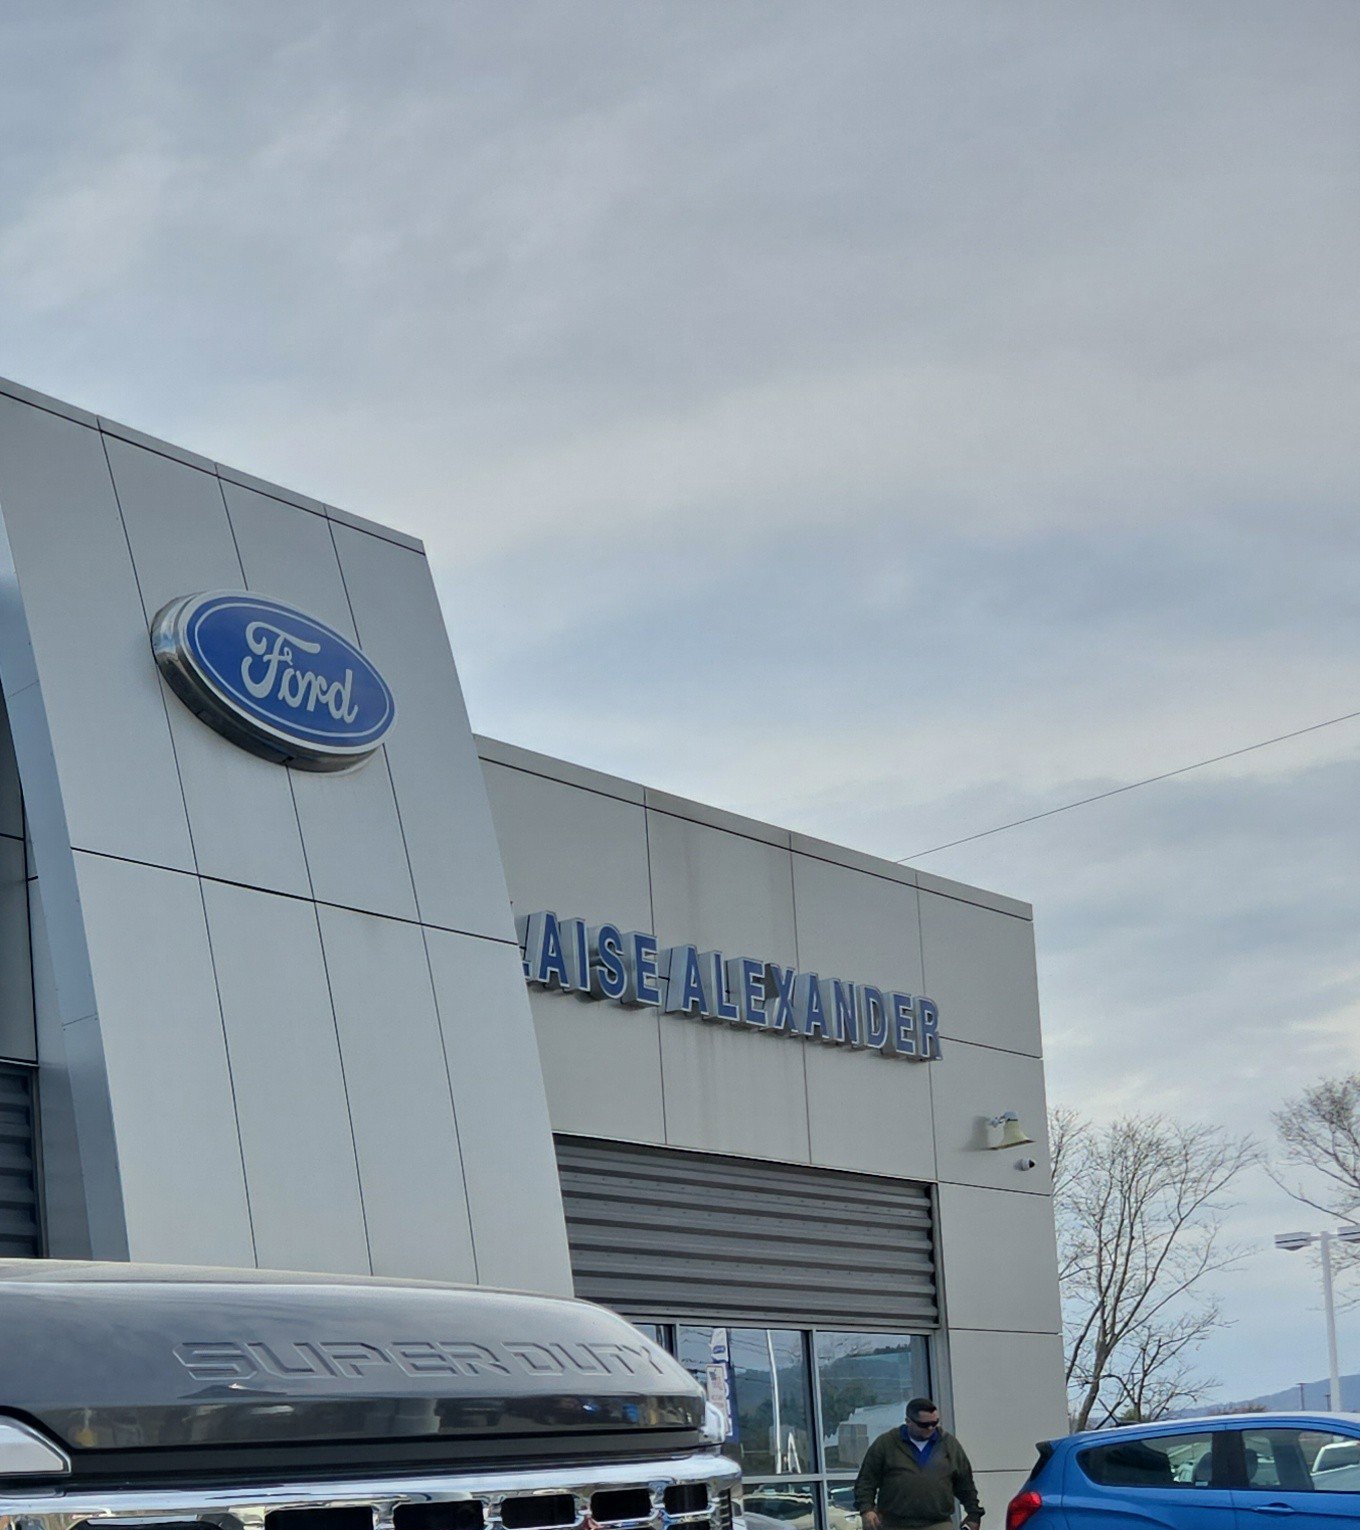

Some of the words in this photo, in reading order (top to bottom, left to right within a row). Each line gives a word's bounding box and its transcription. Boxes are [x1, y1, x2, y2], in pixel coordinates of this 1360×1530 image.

[240, 620, 359, 724] Ford
[522, 909, 662, 1006] AISE
[672, 943, 943, 1061] ALEXANDER
[172, 1340, 512, 1381] SUPER
[501, 1340, 665, 1378] DUTY
